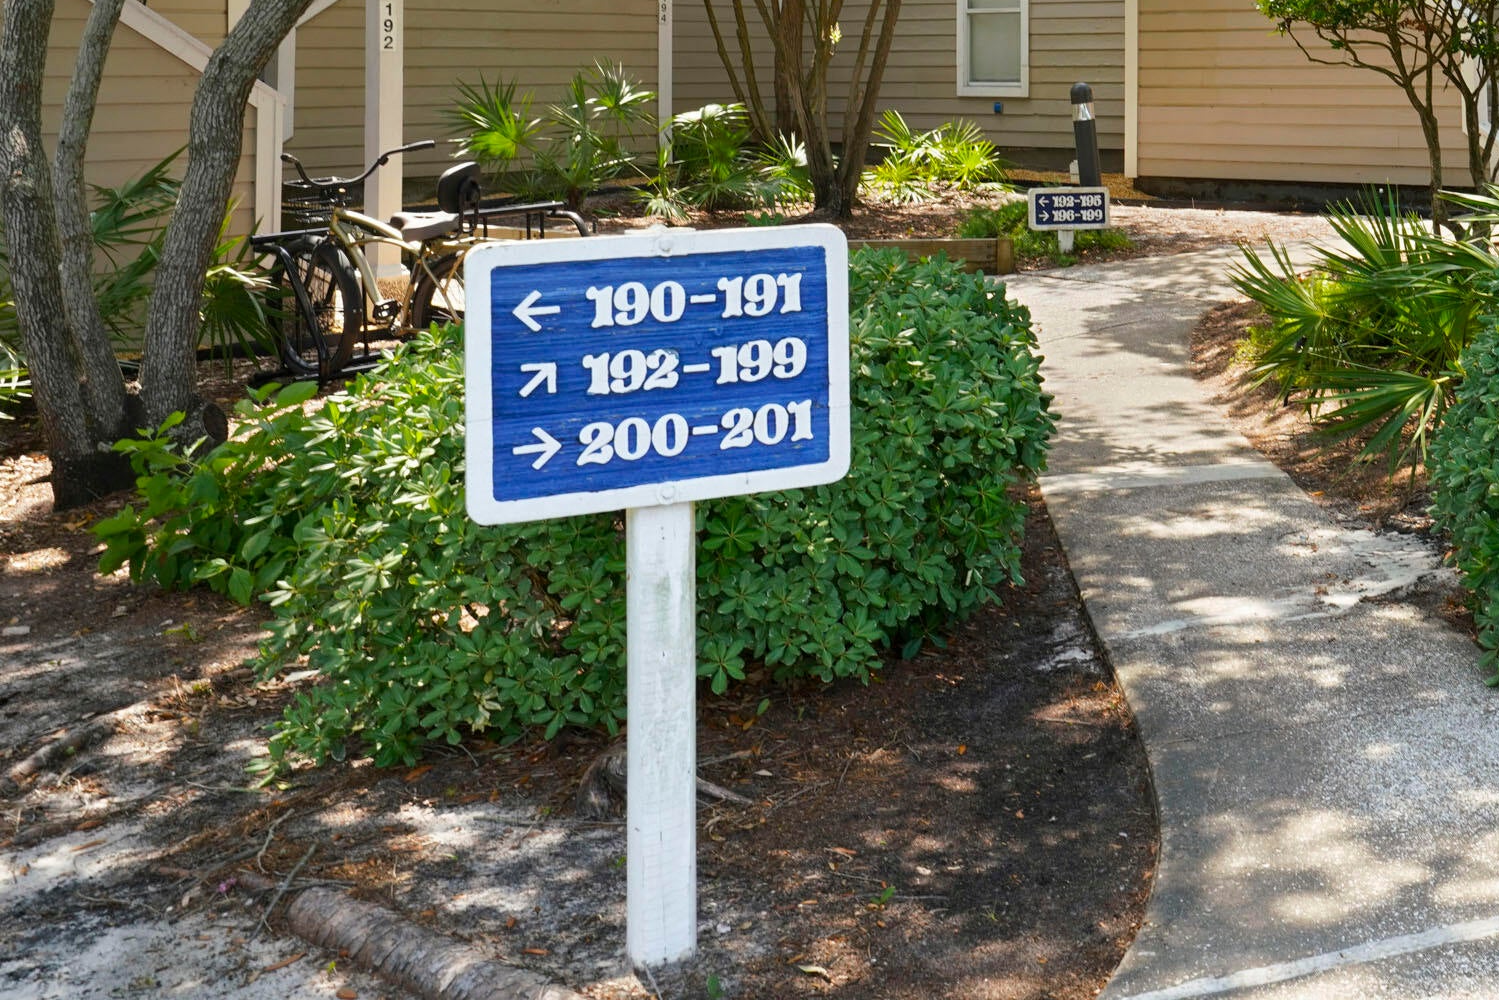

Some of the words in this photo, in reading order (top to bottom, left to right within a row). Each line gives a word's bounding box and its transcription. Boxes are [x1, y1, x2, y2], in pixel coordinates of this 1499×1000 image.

[383, 3, 394, 50] 192
[1052, 194, 1102, 208] 192-195
[1052, 209, 1103, 222] 196-199
[585, 272, 803, 329] 190-191
[582, 336, 808, 396] 192-199
[576, 399, 814, 467] 200-201
